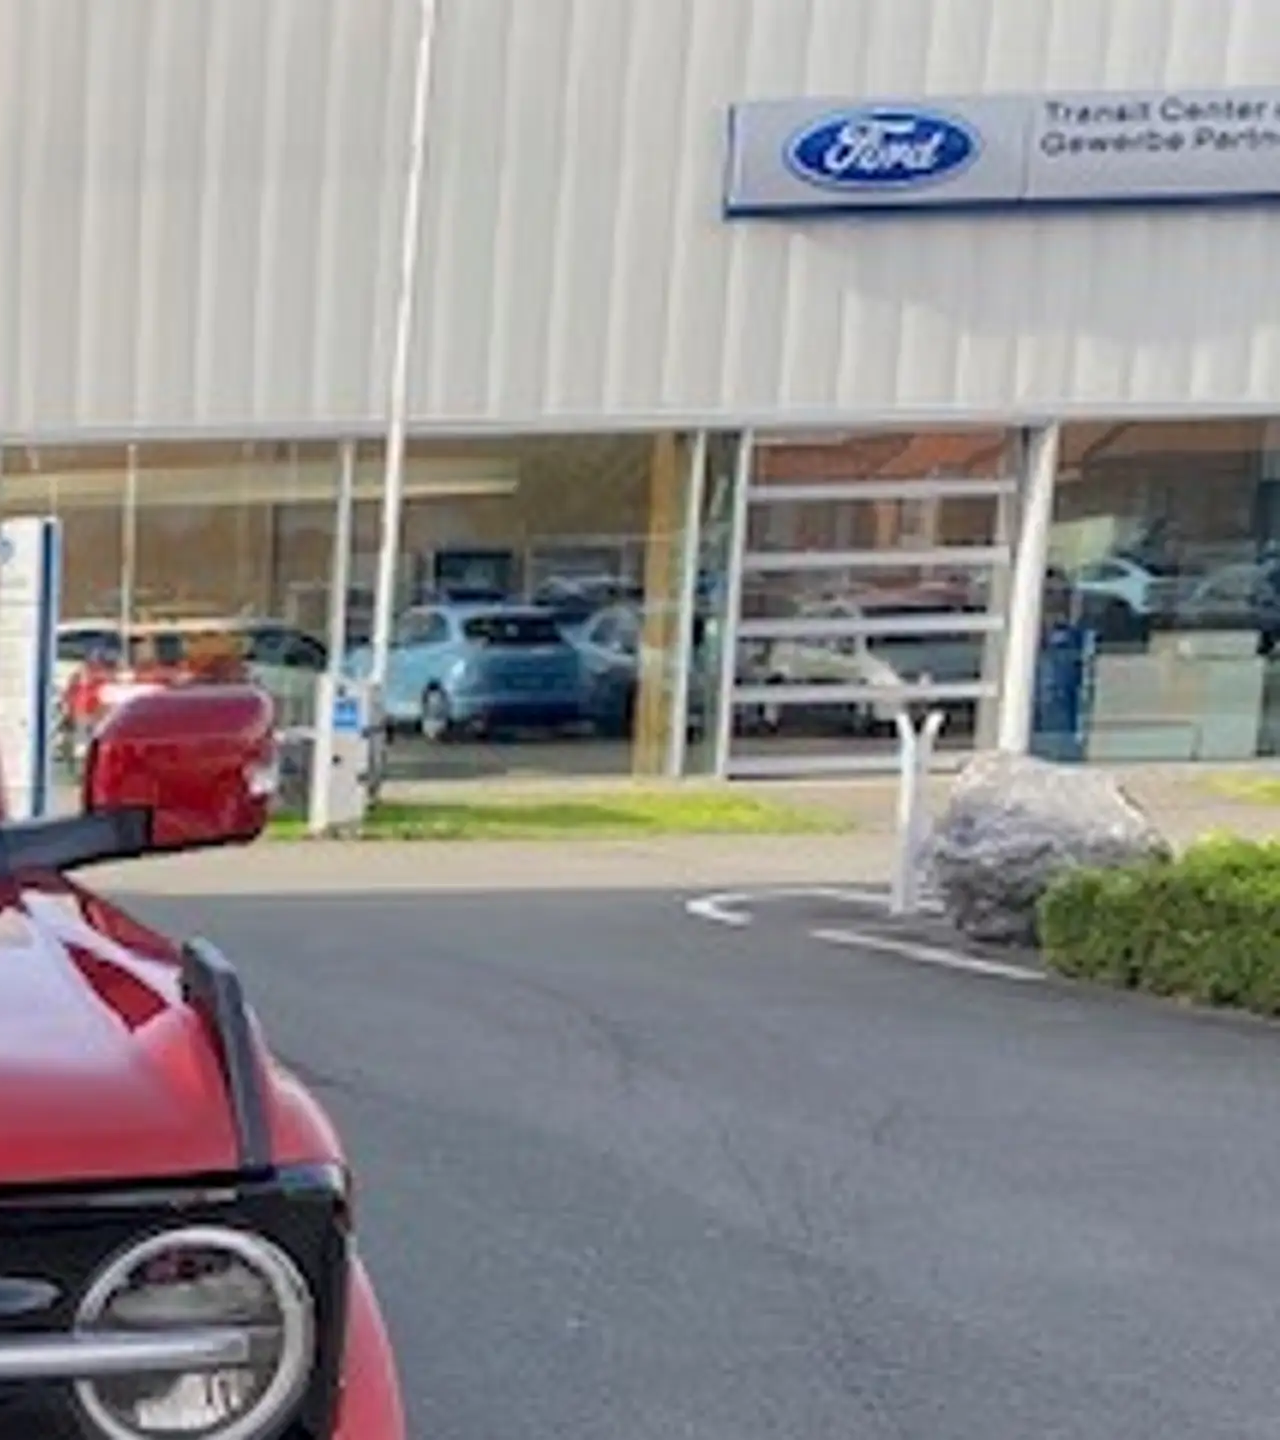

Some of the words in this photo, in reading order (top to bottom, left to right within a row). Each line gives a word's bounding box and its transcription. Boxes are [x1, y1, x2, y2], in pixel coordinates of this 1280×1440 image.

[1044, 101, 1151, 123] Transit
[1159, 98, 1266, 123] Center
[824, 115, 943, 170] Ford
[1041, 131, 1185, 157] Gewerbe
